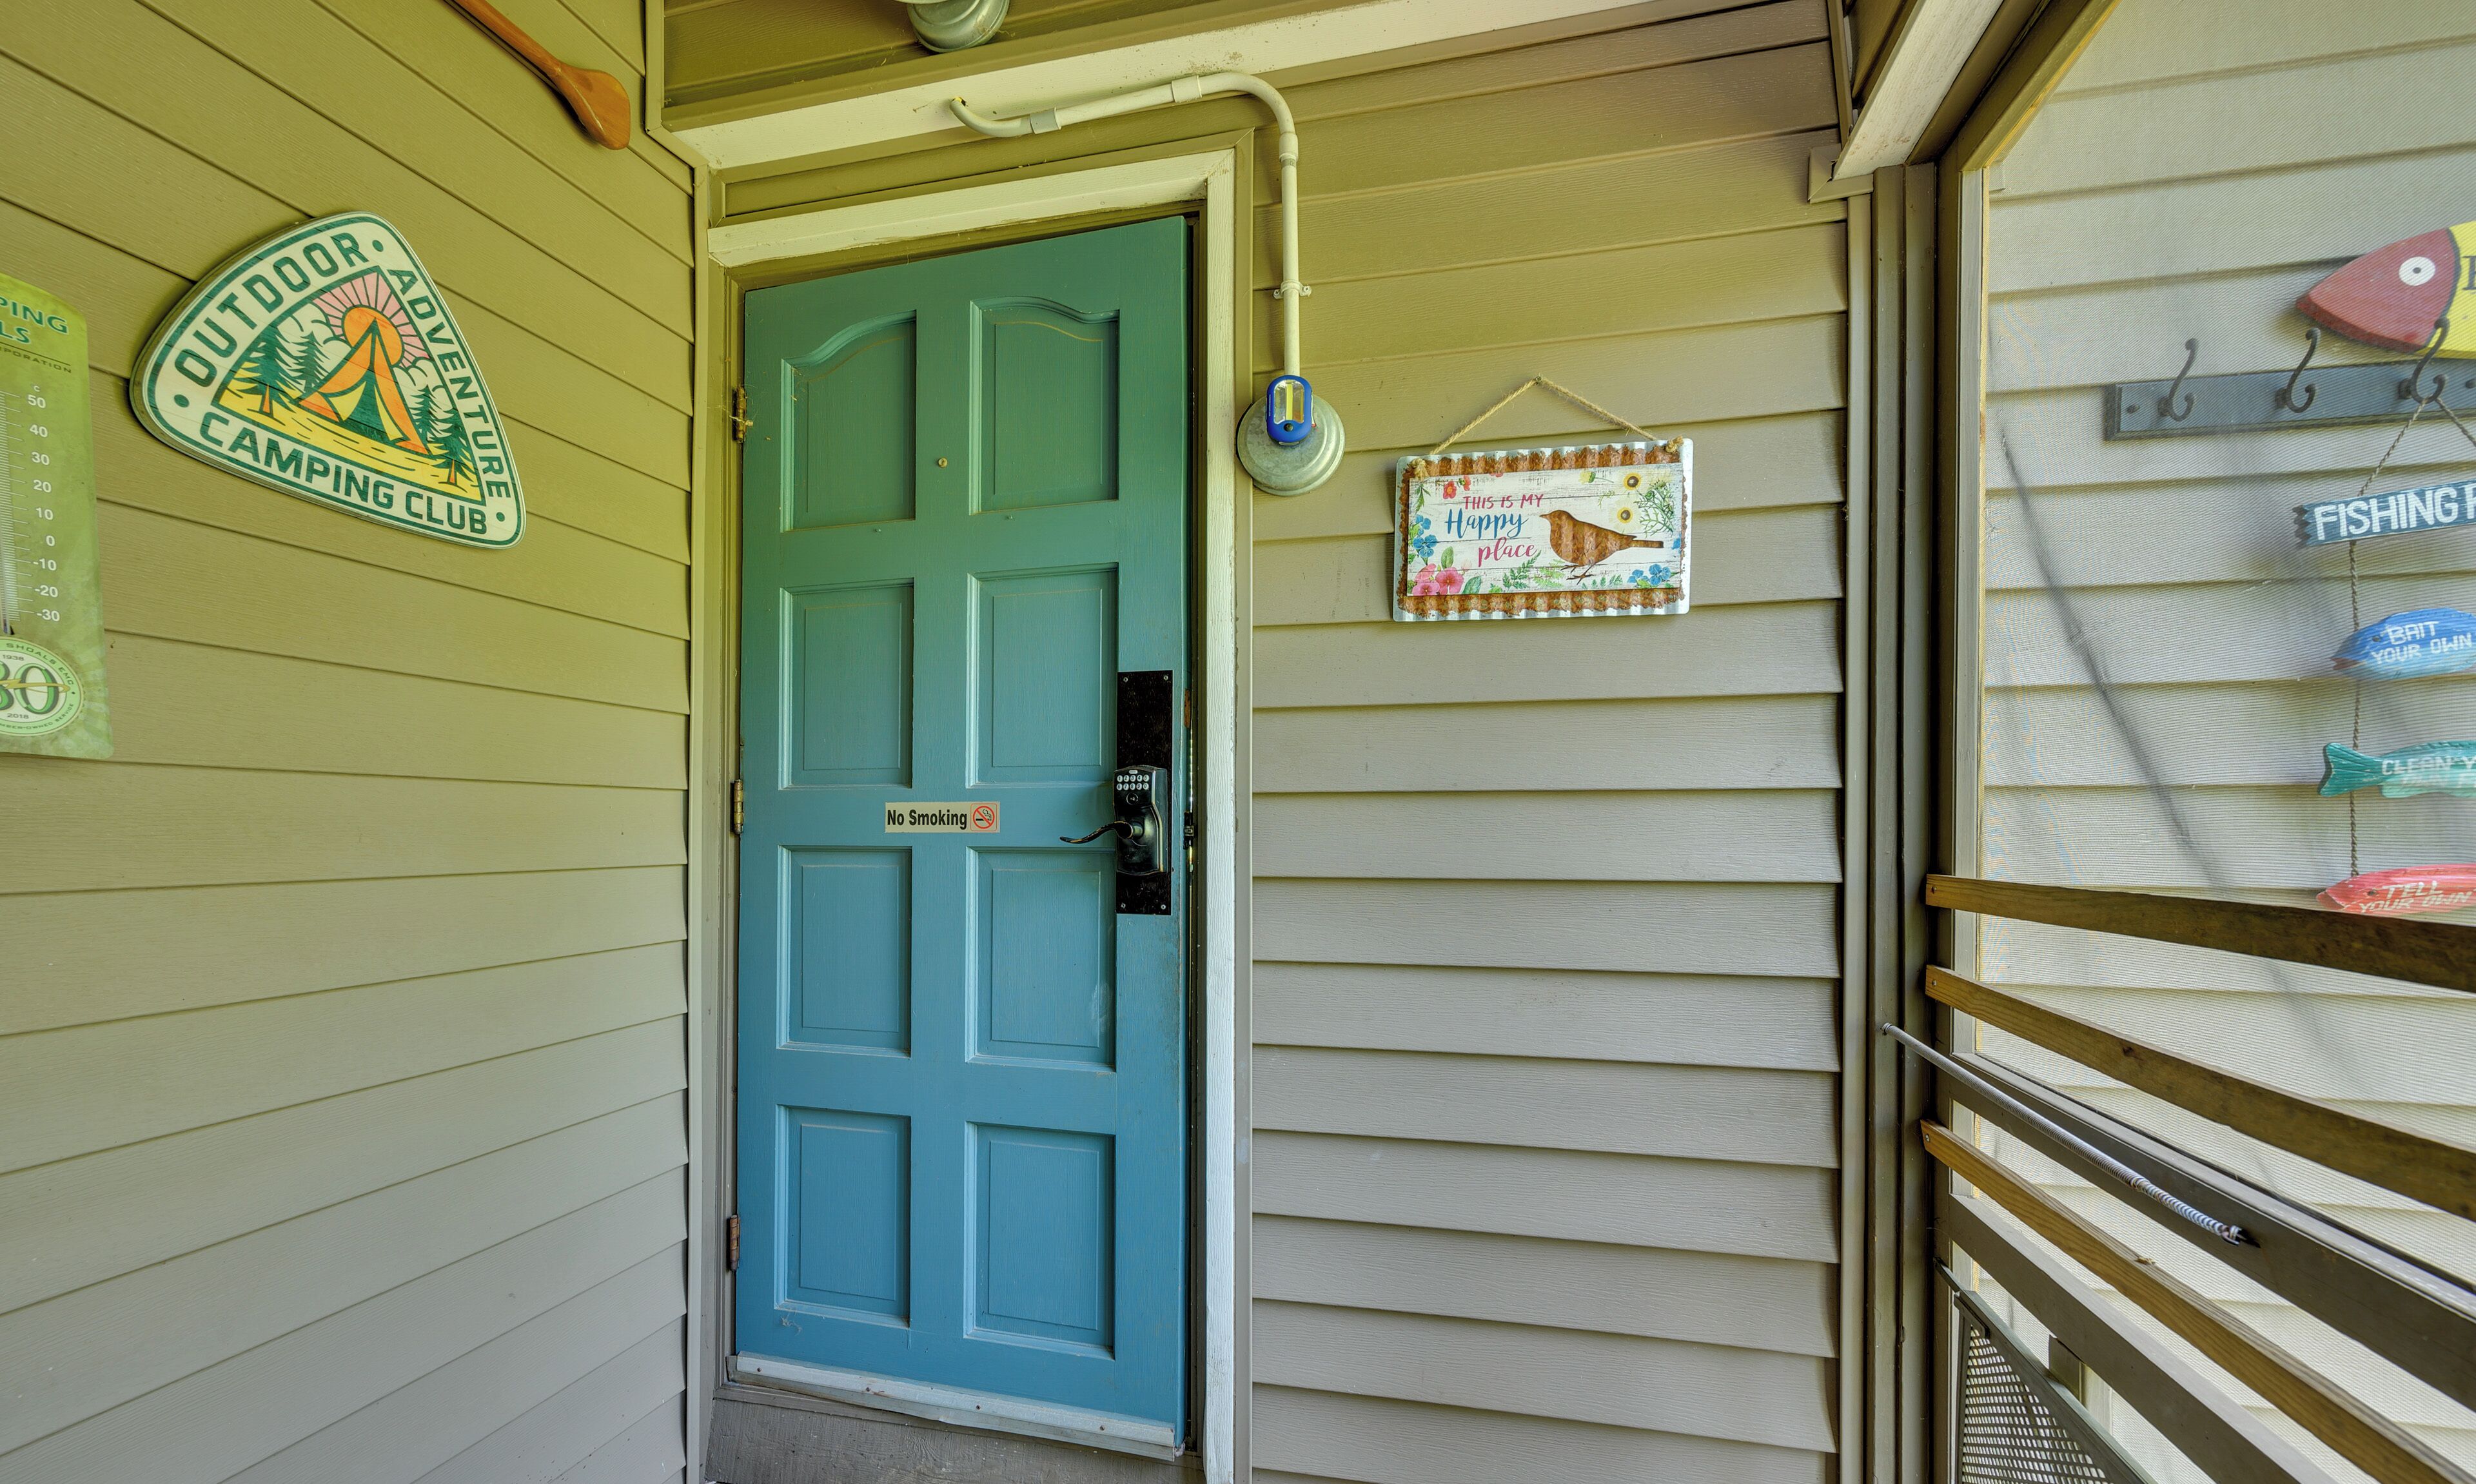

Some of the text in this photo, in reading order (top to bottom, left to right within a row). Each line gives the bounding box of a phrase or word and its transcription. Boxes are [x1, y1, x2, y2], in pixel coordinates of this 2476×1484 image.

[174, 231, 371, 388] OUTDOOR
[0, 347, 72, 373] PORATION
[387, 268, 512, 500] ADVENTURE
[27, 395, 46, 408] 50
[30, 424, 48, 438] 40
[32, 452, 50, 465] 30
[199, 411, 488, 536] CAMPING CLUB
[34, 480, 52, 493] 20
[1462, 494, 1544, 510] THIS IS MY
[36, 507, 54, 520] 10
[2314, 487, 2458, 540] FISHING
[1445, 508, 1529, 540] Happy
[46, 535, 55, 546] 0
[1479, 536, 1538, 567] place
[33, 558, 57, 571] -10
[35, 585, 58, 598] -20
[37, 609, 60, 621] -30
[2386, 621, 2439, 645] BAIT
[2371, 632, 2472, 665] YOUR OWN
[6, 643, 74, 685] SHOALS EMC
[55, 703, 74, 723] SERVICE
[2382, 756, 2451, 775] CLEAN
[887, 809, 967, 830] No Smoking
[2382, 881, 2444, 899] TELL
[2359, 891, 2473, 913] YOUR OWN
